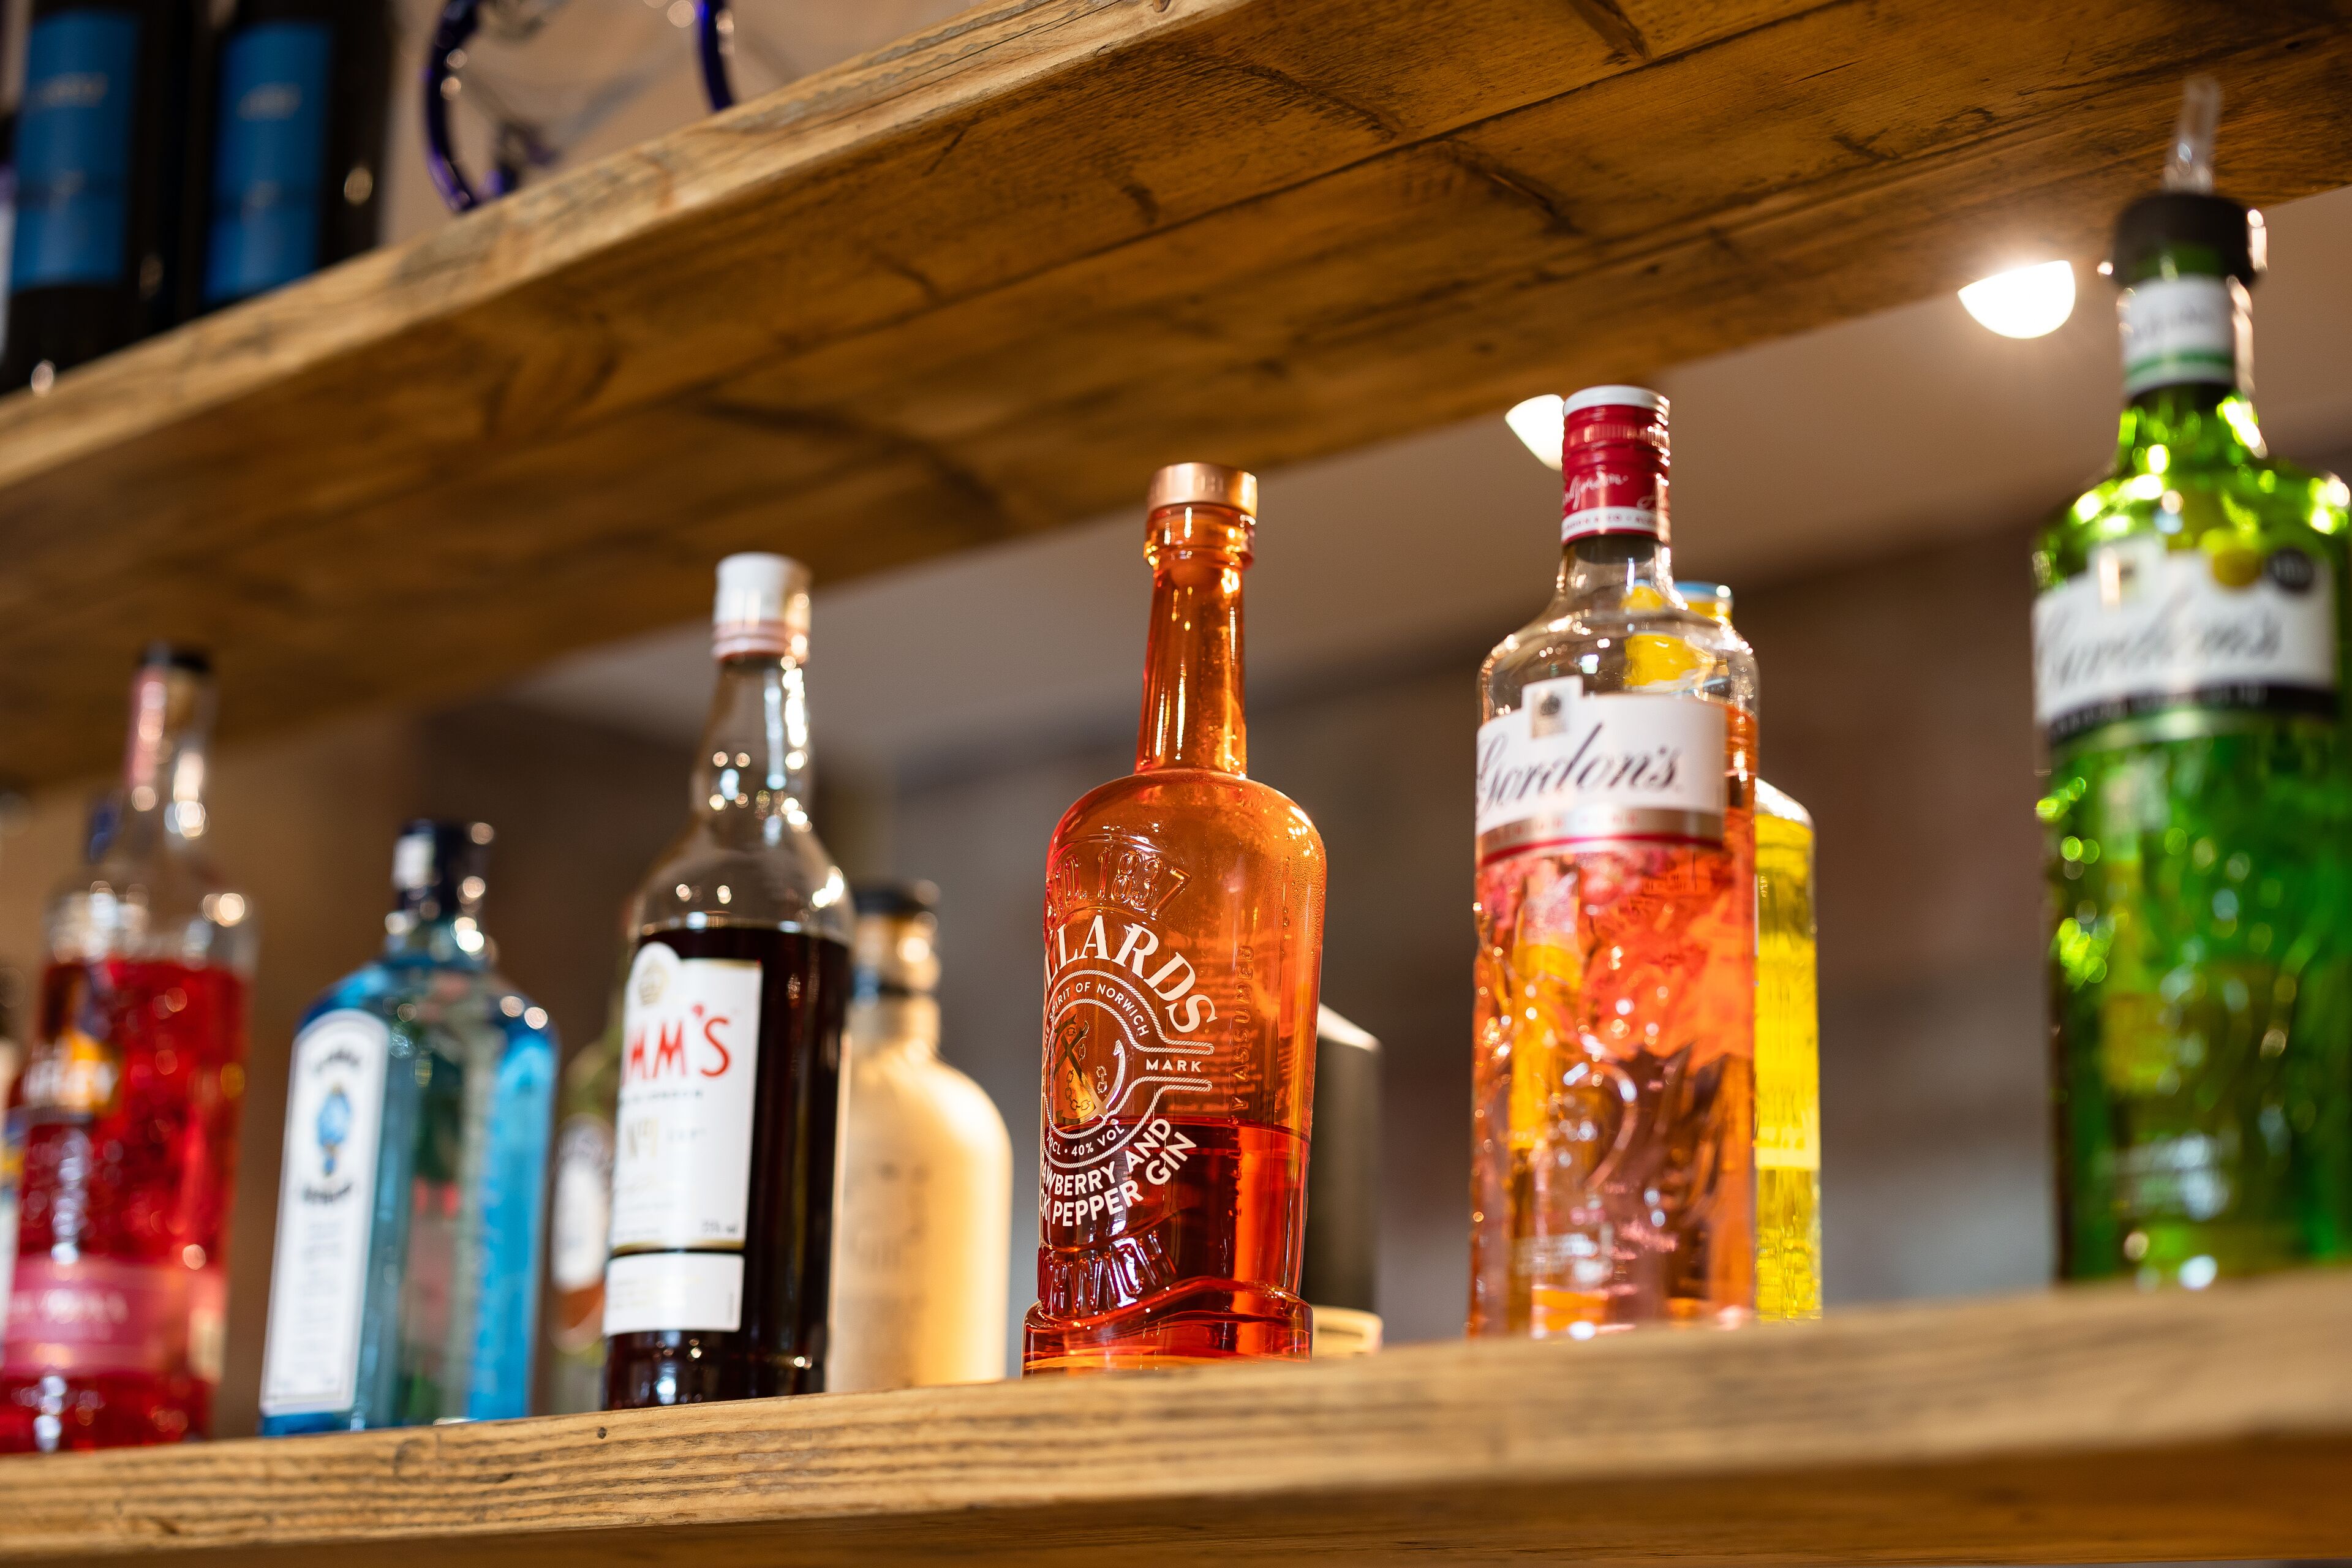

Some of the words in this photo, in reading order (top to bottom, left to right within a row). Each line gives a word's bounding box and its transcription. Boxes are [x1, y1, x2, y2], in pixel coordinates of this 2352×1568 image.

[1098, 846, 1193, 917] 1837
[1049, 987, 1071, 1022] SPIRIT
[1075, 981, 1091, 993] OF
[1096, 984, 1150, 1036] NORWICH
[1145, 1060, 1202, 1073] MARK
[1071, 1142, 1094, 1156] 40%
[1097, 1125, 1125, 1147] VOL
[1125, 1118, 1171, 1173] AND
[1052, 1180, 1144, 1227] PEPPER
[1145, 1131, 1197, 1186] GIN
